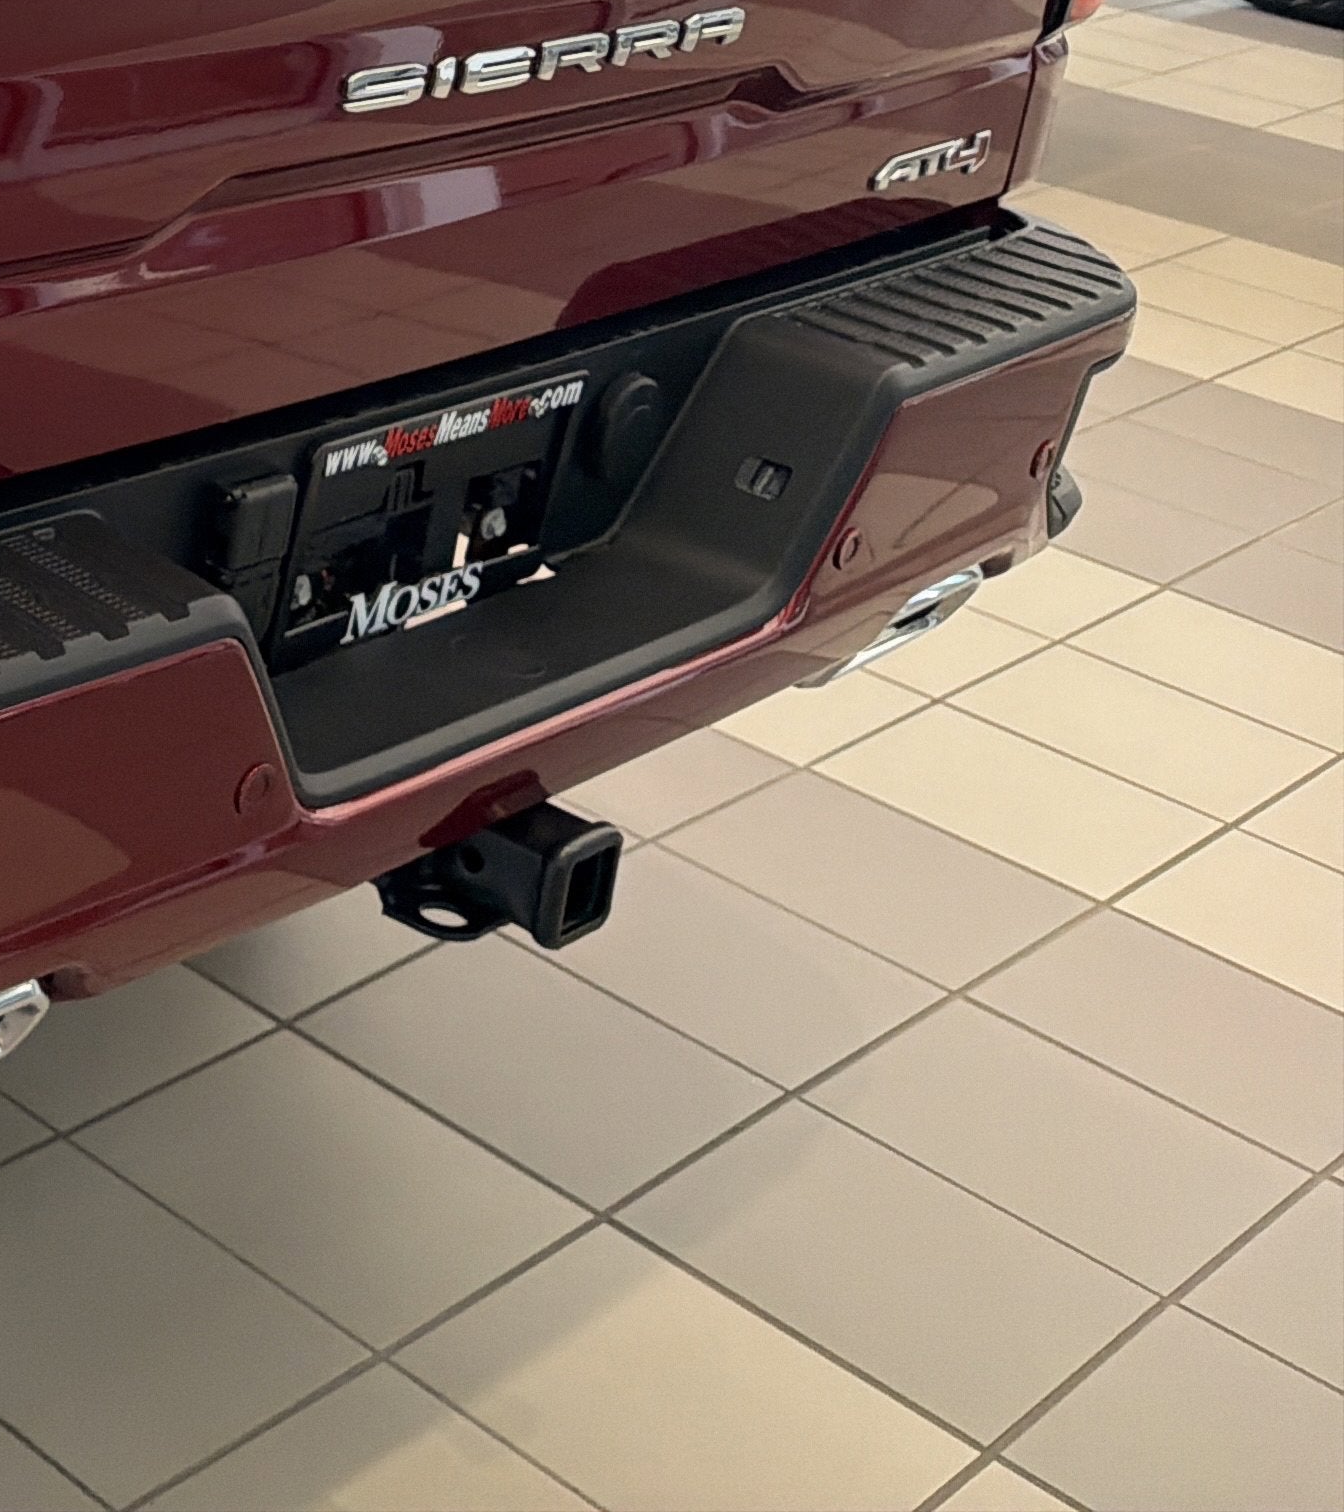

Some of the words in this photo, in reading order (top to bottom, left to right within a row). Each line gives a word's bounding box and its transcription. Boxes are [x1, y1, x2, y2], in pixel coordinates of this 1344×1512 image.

[341, 6, 746, 113] SIERRA
[868, 128, 992, 192] AT4
[339, 560, 485, 645] MOSES
